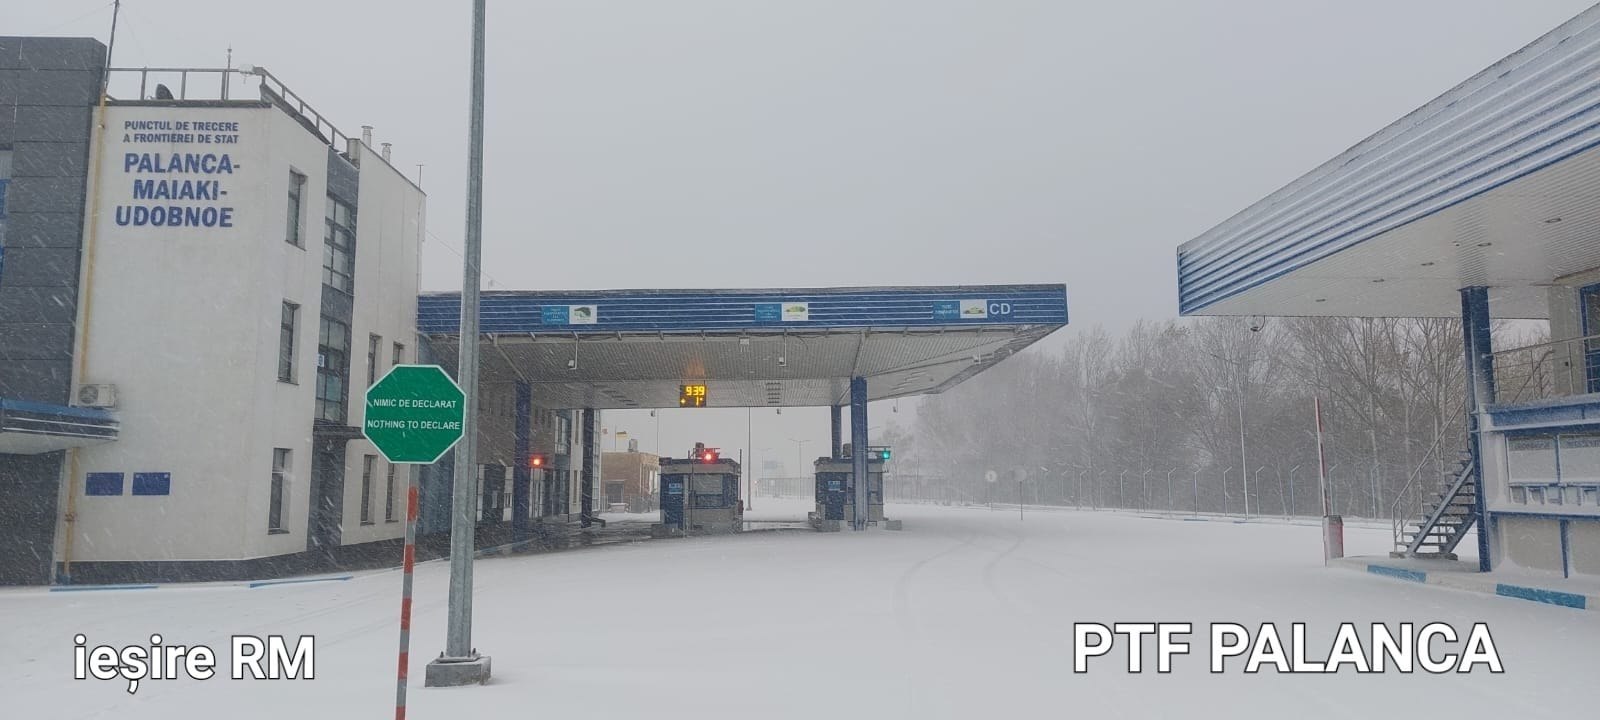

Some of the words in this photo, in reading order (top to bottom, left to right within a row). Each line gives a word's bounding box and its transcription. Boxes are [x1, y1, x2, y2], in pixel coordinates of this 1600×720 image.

[124, 120, 172, 131] PUNCTUL
[175, 121, 190, 131] DE
[192, 121, 239, 132] TRECERE
[122, 133, 131, 143] A
[133, 133, 194, 143] FRONTIEREI
[197, 134, 212, 144] DE
[214, 134, 239, 144] STAT
[124, 152, 241, 174] PALANCA-
[133, 179, 228, 201] MAIAKI-
[115, 205, 234, 228] UDOBNOE
[989, 302, 1011, 315] CD
[373, 398, 397, 408] NIMIC
[398, 399, 411, 408] DE
[412, 400, 457, 409] DECLARAT
[367, 419, 406, 429] NOTHING
[408, 421, 419, 429] TO
[420, 421, 460, 430] DECLARE
